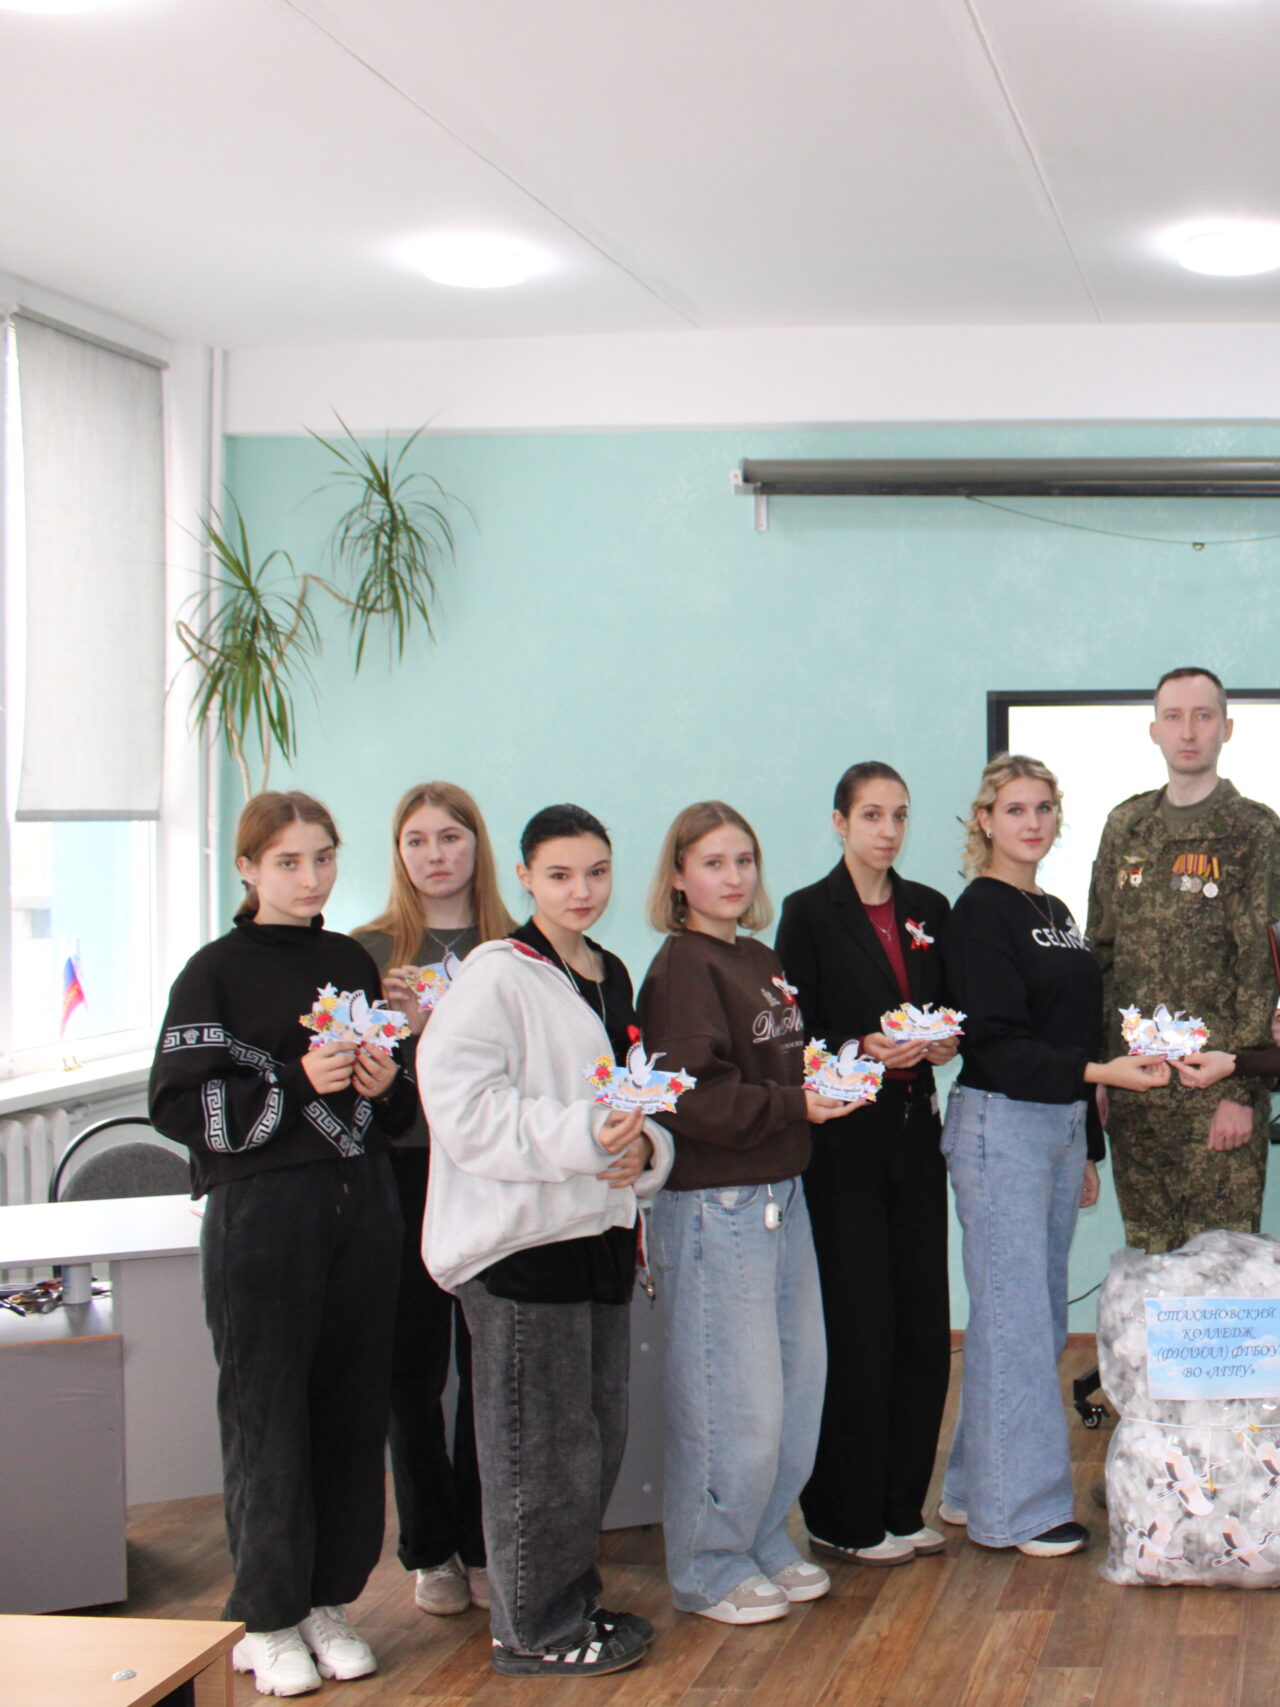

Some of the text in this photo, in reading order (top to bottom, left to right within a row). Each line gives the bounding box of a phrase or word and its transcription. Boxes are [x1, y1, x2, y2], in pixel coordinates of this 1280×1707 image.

[1158, 1307, 1276, 1322] СТАХАНОВСКИЙ
[1182, 1327, 1256, 1341] КОЛЛЕДЖ
[1157, 1344, 1280, 1362] (ФИЛИАЛ) ФГБОУ
[1182, 1366, 1203, 1379] ВО
